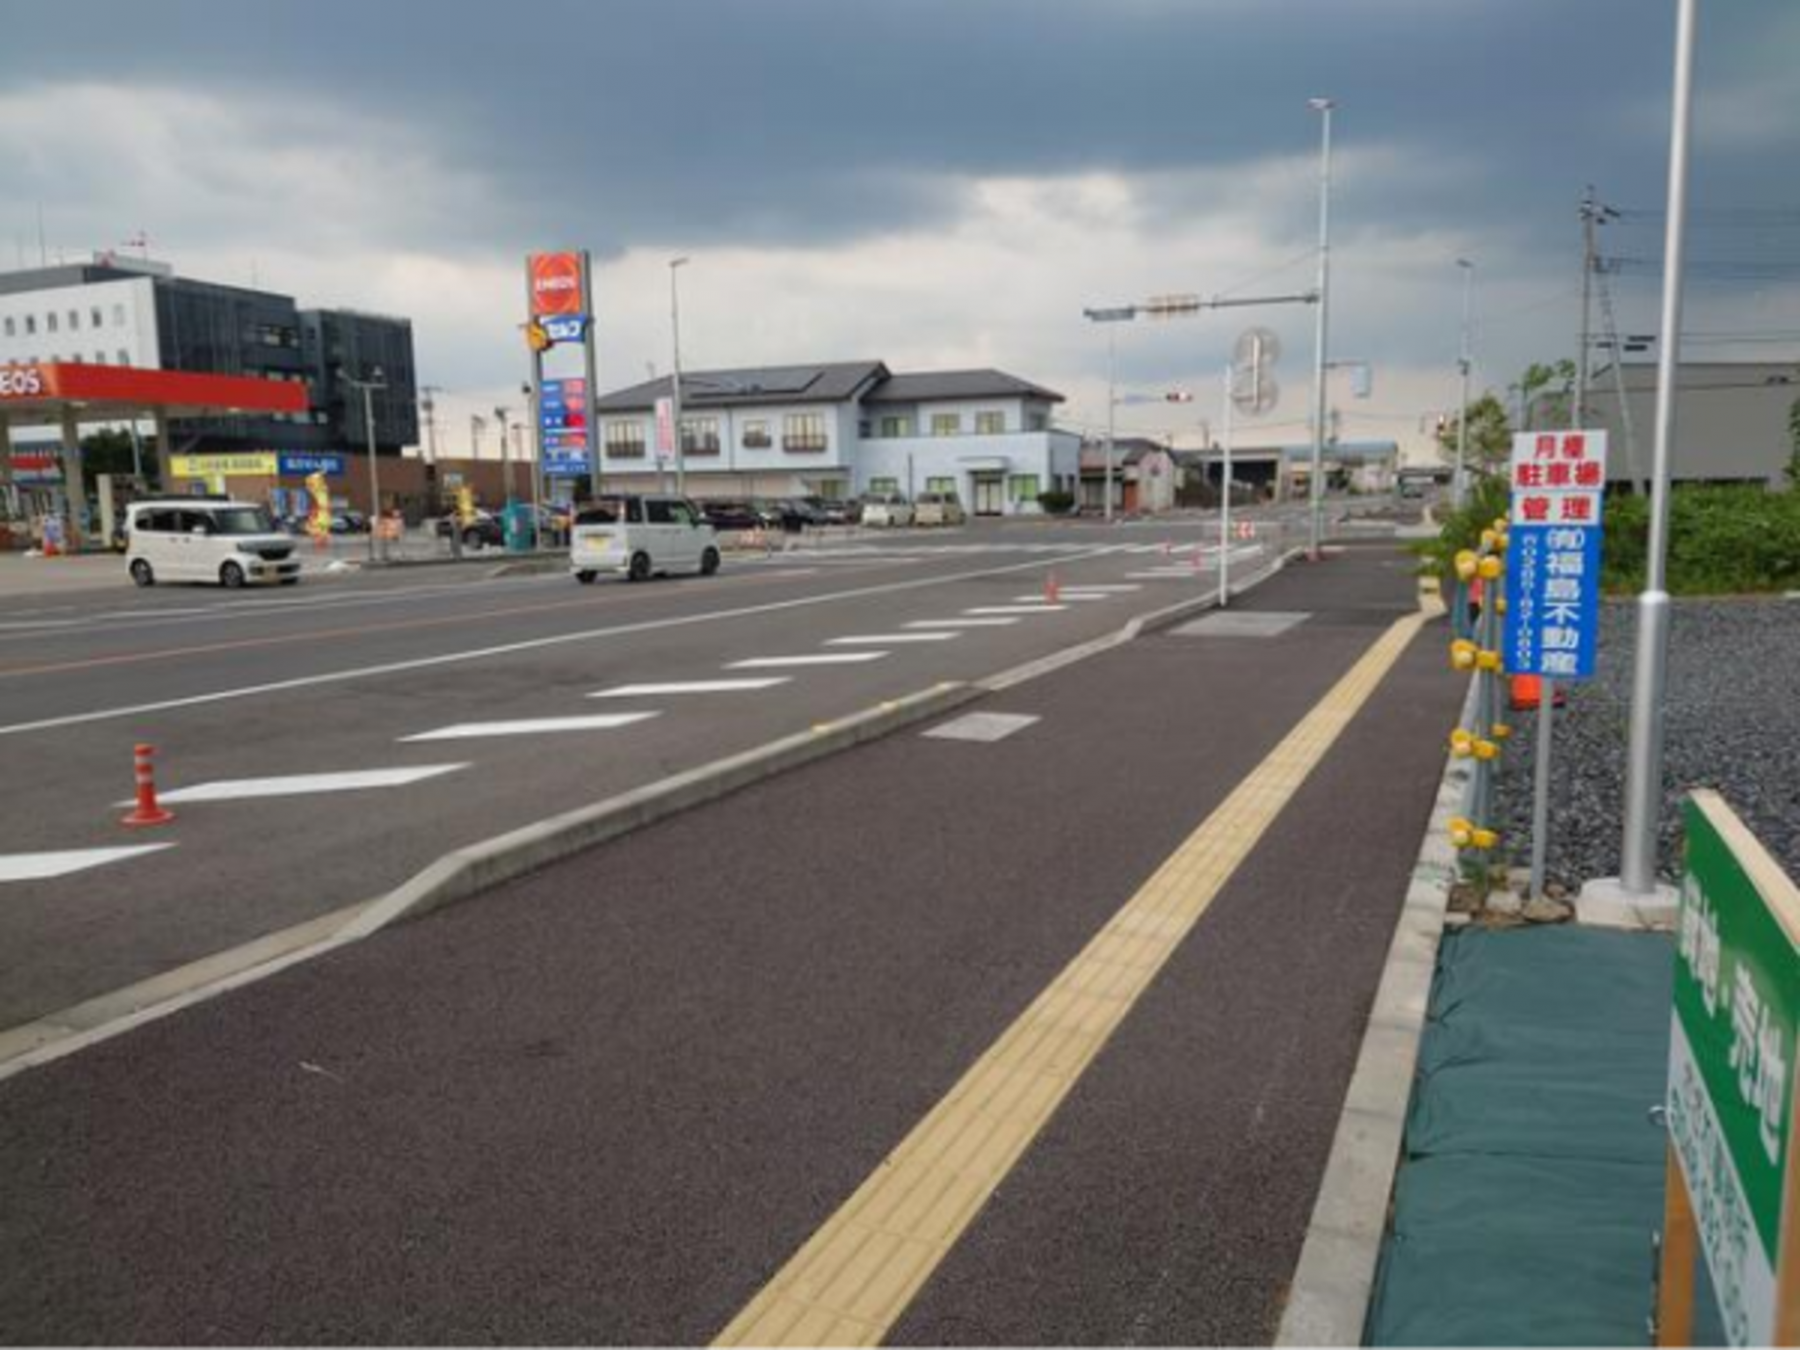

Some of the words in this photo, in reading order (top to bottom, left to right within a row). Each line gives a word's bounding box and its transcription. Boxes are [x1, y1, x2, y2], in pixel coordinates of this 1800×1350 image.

[1515, 461, 1602, 487] 駐車場
[1522, 495, 1591, 520] 管理
